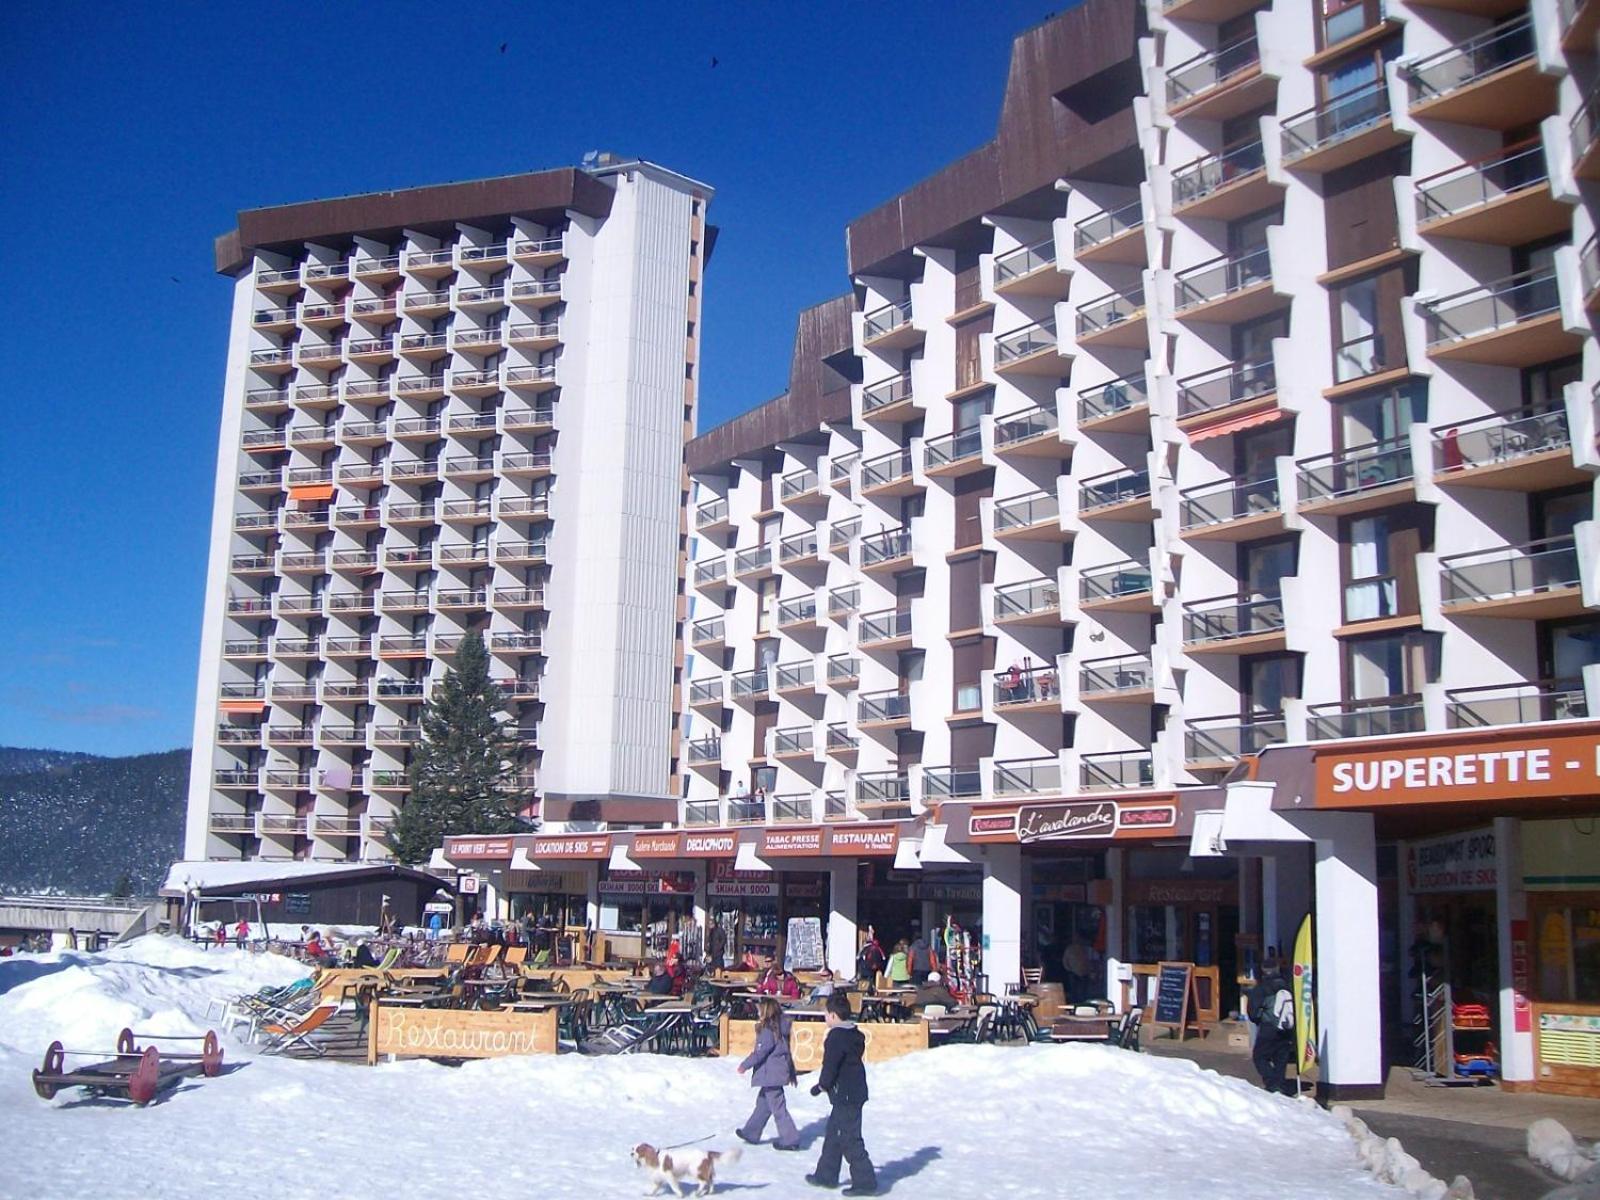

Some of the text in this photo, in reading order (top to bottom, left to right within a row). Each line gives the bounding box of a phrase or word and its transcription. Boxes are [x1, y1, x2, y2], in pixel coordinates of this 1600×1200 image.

[1332, 749, 1551, 792] SUPERETTE
[1020, 804, 1114, 838] L'avalanche
[766, 834, 819, 844] TABAC PRESSE
[832, 833, 895, 844] RESTAURANT
[535, 843, 564, 854] LOCATION
[565, 843, 574, 853] DE
[575, 841, 589, 852] SKIS
[765, 842, 820, 850] ALIMENTATION
[750, 884, 769, 894] 2000
[384, 1008, 543, 1053] Restaurant
